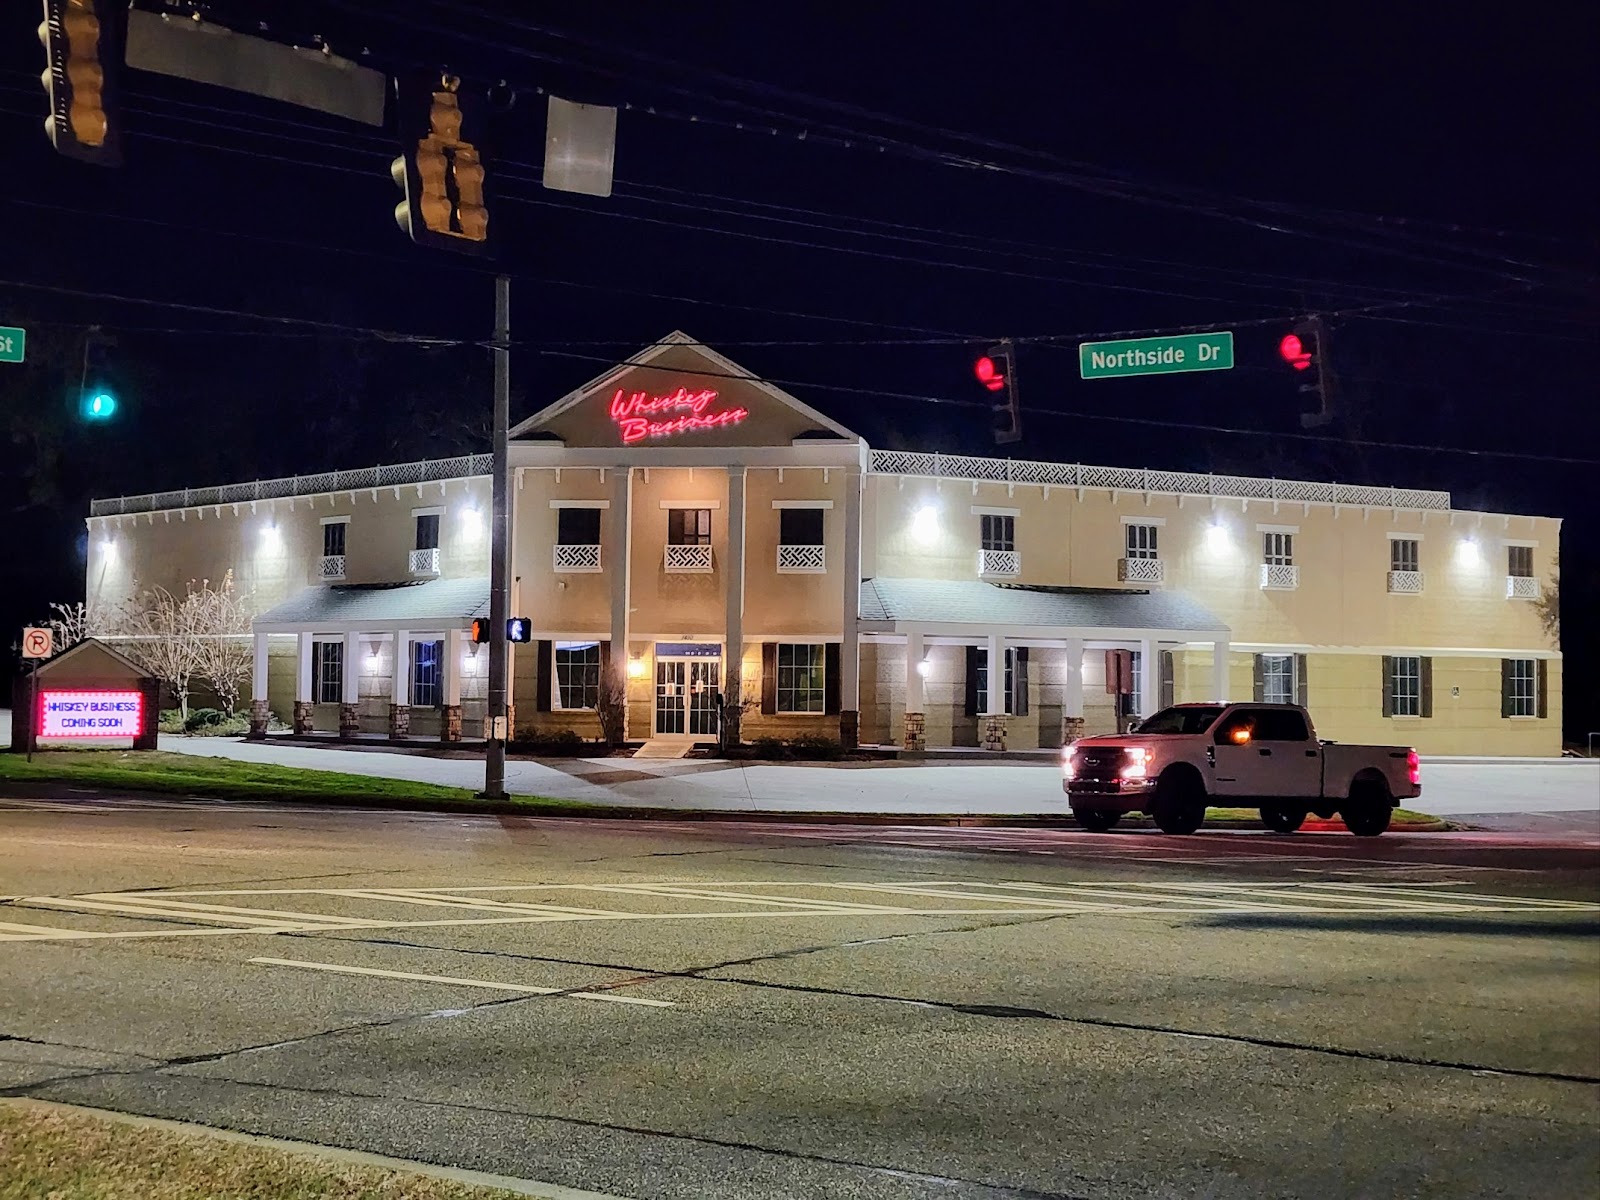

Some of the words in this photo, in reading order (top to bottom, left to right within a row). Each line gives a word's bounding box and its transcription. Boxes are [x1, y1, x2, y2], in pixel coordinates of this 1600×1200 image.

[1091, 346, 1185, 369] Northside
[1198, 343, 1220, 361] Dr
[610, 388, 718, 417] Whiskey
[619, 408, 748, 441] Business
[48, 702, 88, 711] WHISKEY
[90, 702, 136, 711] BUSINESS
[61, 718, 96, 727] COMING
[97, 718, 123, 727] SOON
